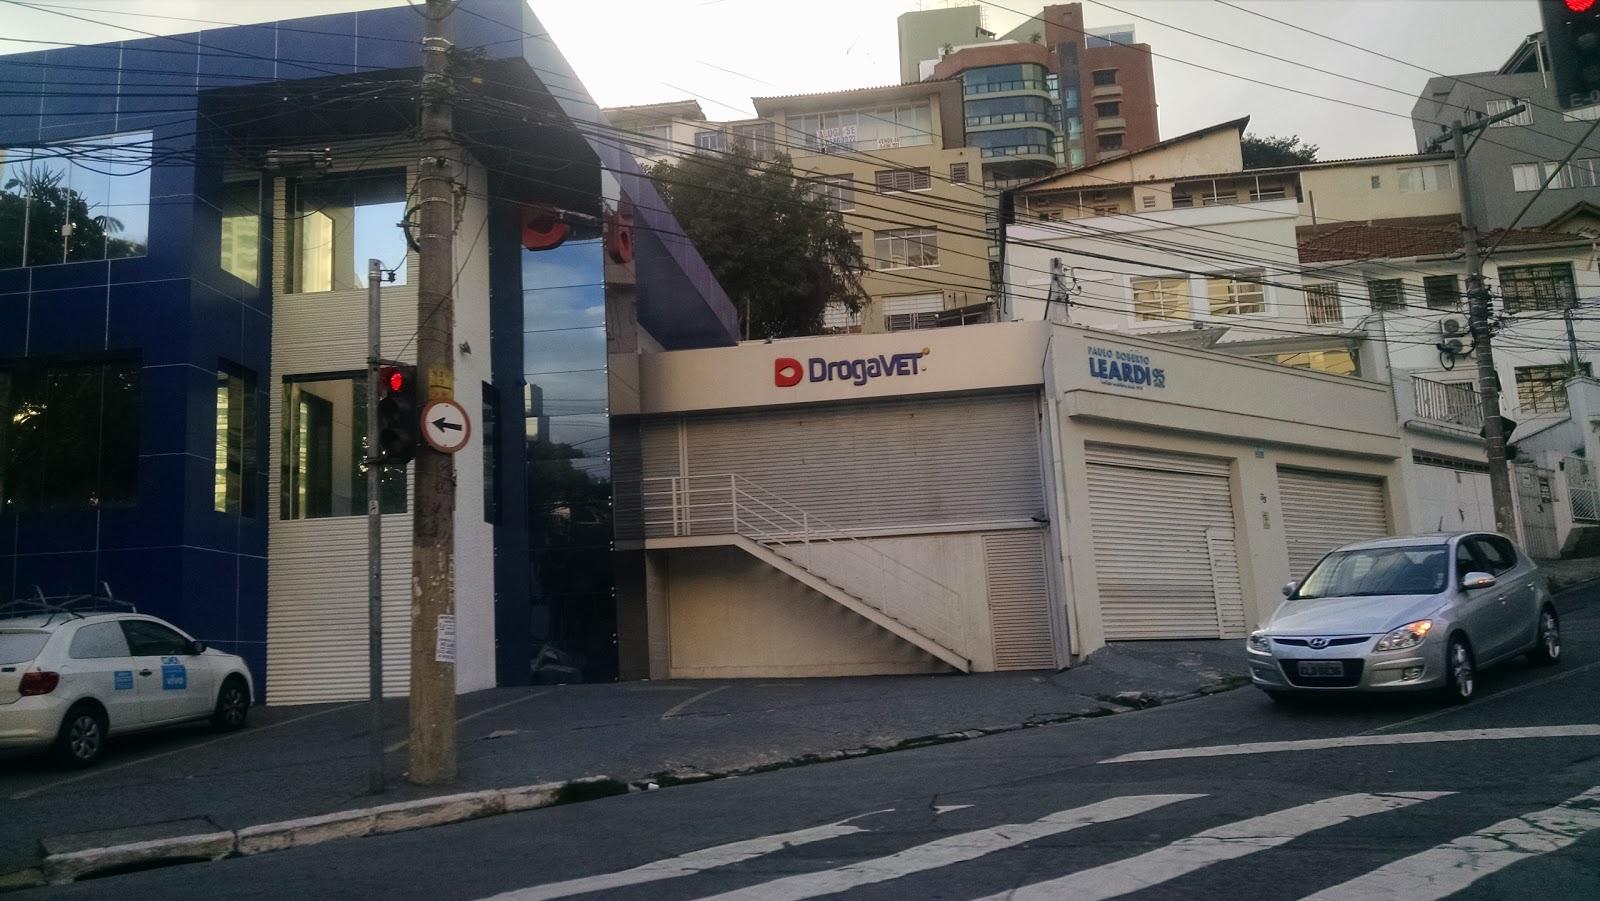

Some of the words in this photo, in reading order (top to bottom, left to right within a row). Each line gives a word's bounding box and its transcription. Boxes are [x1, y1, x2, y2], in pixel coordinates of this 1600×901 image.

[1088, 347, 1113, 358] PAULO
[1116, 352, 1150, 364] ROBERTO
[1089, 358, 1151, 385] LEARDI
